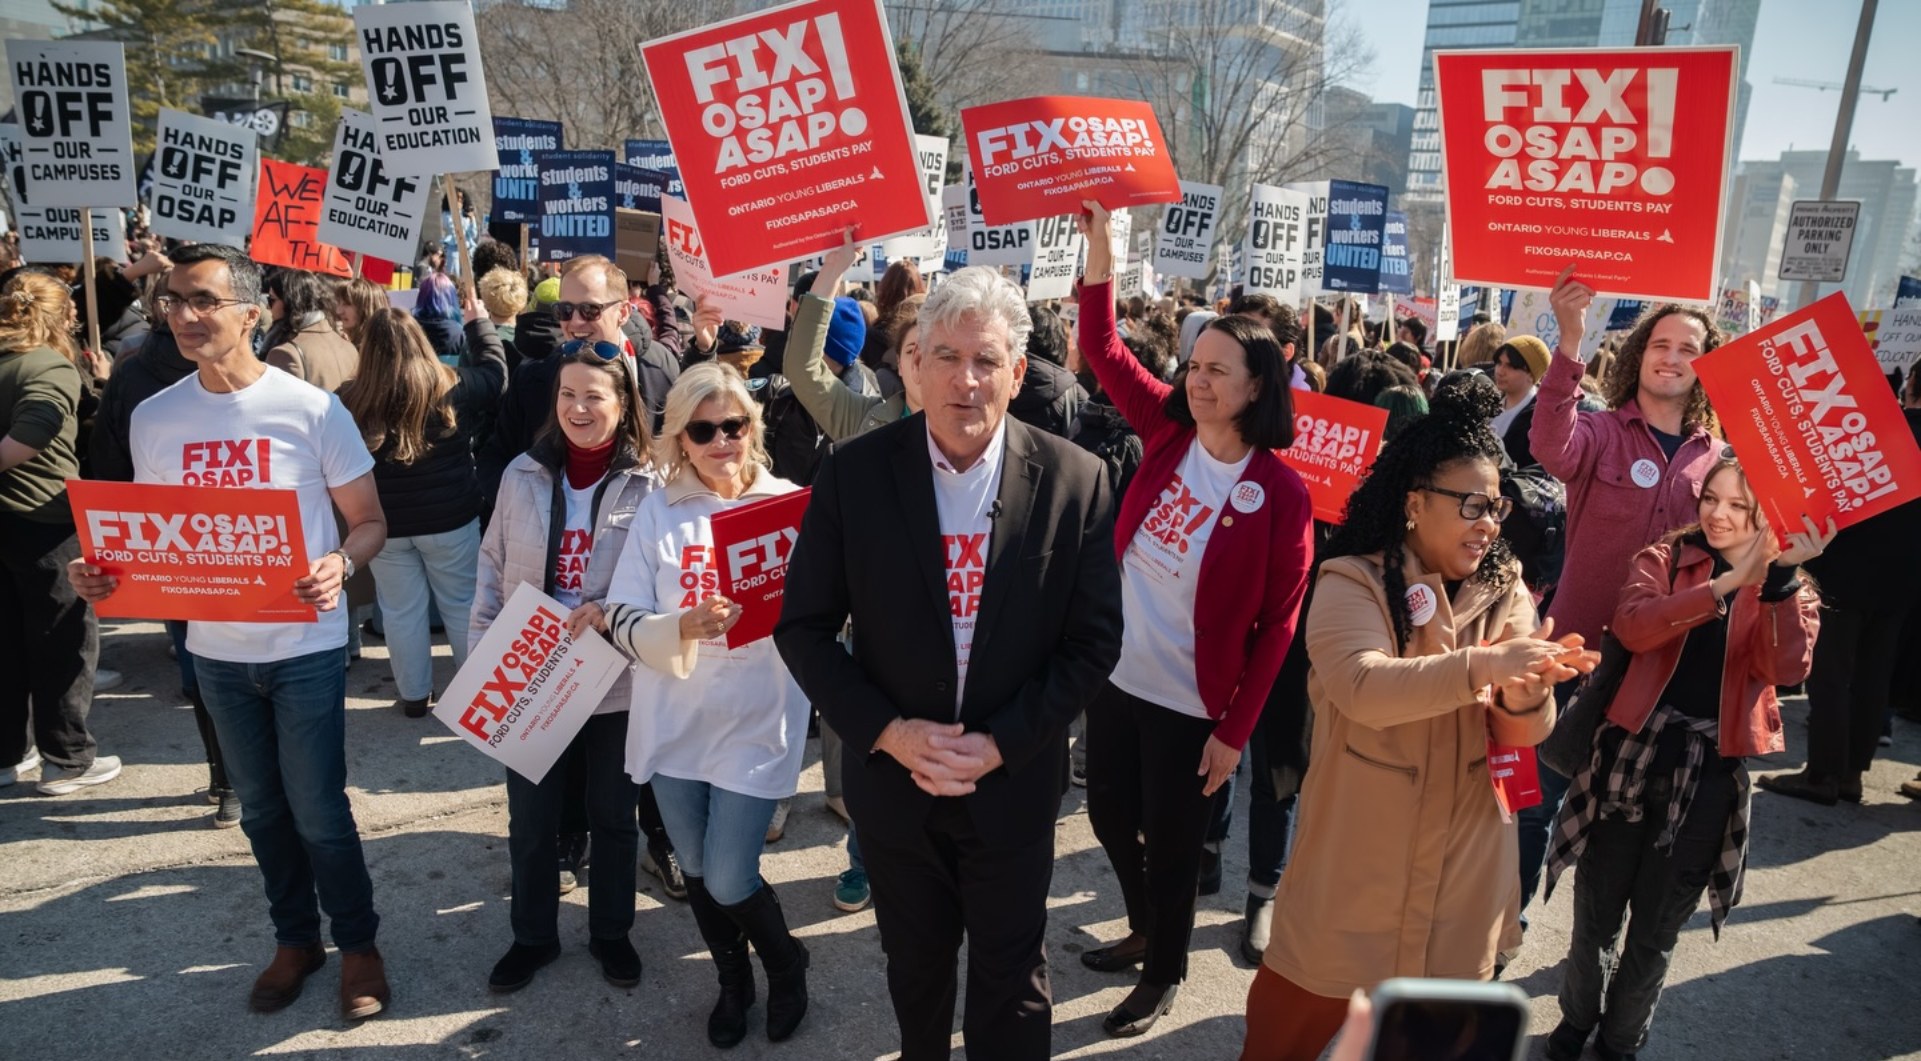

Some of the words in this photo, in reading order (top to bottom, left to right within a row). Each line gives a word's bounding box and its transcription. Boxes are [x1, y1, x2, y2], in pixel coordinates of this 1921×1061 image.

[363, 23, 463, 54] HANDS
[17, 61, 111, 87] HANDS
[371, 53, 468, 106] OFF
[21, 91, 113, 137] OFF
[408, 106, 449, 126] OUR
[701, 77, 827, 138] OSAP
[164, 127, 244, 160] HANDS
[385, 126, 481, 151] EDUCATION
[496, 133, 557, 151] students
[977, 118, 1067, 166] FIX
[1484, 125, 1638, 160] OSAP
[54, 141, 91, 159] OUR
[574, 153, 610, 161] solidarity
[31, 164, 120, 181] CAMPUSES
[161, 146, 242, 190] OFF
[720, 173, 751, 190] FORD
[753, 162, 789, 184] CUTS,
[790, 147, 850, 173] STUDENTS
[851, 140, 873, 156] PAY
[984, 162, 1020, 178] FORD
[1023, 152, 1063, 171] CUTS,
[1065, 147, 1131, 161] STUDENTS
[1135, 147, 1156, 157] PAY
[265, 165, 320, 201] WE
[541, 165, 609, 186] students
[1017, 177, 1054, 190] ONTARIO
[1054, 170, 1083, 183] YOUNG
[1084, 165, 1122, 176] LIBERALS
[1043, 176, 1114, 197] FIXOSAPASAP.CA
[182, 183, 215, 202] OUR
[568, 181, 583, 198] &
[728, 197, 775, 216] ONTARIO
[776, 187, 814, 203] YOUNG
[815, 174, 865, 194] LIBERALS
[157, 194, 236, 230] OSAP
[355, 197, 389, 217] OUR
[545, 196, 608, 215] workers
[766, 200, 858, 230] FIXOSAPASAP.CA
[1254, 201, 1300, 222] HANDS
[1331, 198, 1382, 215] students
[1488, 194, 1523, 206] FORD
[1525, 196, 1567, 210] CUTS,
[1570, 198, 1643, 213] STUDENTS
[1646, 202, 1672, 214] PAY
[329, 209, 409, 241] EDUCATION
[541, 215, 610, 237] UNITED
[1165, 207, 1212, 238] OFF
[1351, 214, 1362, 230] &
[1488, 222, 1542, 234] ONTARIO
[1544, 225, 1588, 237] YOUNG
[1591, 227, 1650, 241] LIBERALS
[1792, 216, 1854, 229] AUTHORIZED
[24, 226, 110, 241] CAMPUES
[972, 228, 1030, 251] OSAP
[1175, 237, 1194, 249] OUR
[1252, 219, 1298, 252] OFF
[1331, 229, 1379, 244] workers
[1797, 229, 1842, 242] PARKING
[289, 241, 350, 272] THIS
[1048, 249, 1065, 262] OUR
[1160, 248, 1204, 263] CAMPUSES
[1265, 252, 1284, 265] OUR
[1326, 244, 1378, 269] UNITED
[1524, 245, 1633, 262] FIXOSAPASAP.CA
[1804, 242, 1830, 254] ONLY
[761, 274, 779, 285] PAY
[1034, 264, 1072, 279] CAMPUSES
[1250, 266, 1295, 289] OSAP
[1525, 268, 1554, 277] Authorized
[1882, 332, 1902, 343] OFF
[1772, 318, 1857, 425] FIX
[1751, 379, 1773, 416] ONTARIO
[1771, 415, 1788, 446] YOUNG
[1784, 443, 1808, 484] LIBERALS
[1757, 339, 1785, 376] FORD
[1777, 378, 1804, 420] CUTS,
[1798, 420, 1842, 490] STUDENTS
[1832, 488, 1853, 513] PAY
[1750, 408, 1790, 480] FIXOSAPASAP.CA
[1280, 448, 1337, 470] STUDENTS
[1340, 462, 1361, 476] PAY
[85, 509, 193, 553] FIX
[95, 549, 134, 562] FORD
[138, 551, 182, 566] CUTS,
[187, 553, 263, 566] STUDENTS
[267, 555, 293, 567] PAY
[131, 574, 172, 582] ONTARIO
[173, 575, 206, 584] YOUNG
[207, 576, 249, 585] LIBERALS
[732, 574, 767, 594] FORD
[161, 586, 240, 596] FIXOSAPASAP.CA
[458, 665, 528, 741] FIX
[488, 723, 510, 748] FORD
[506, 696, 533, 724] CUTS,
[527, 645, 568, 695] STUDENTS
[520, 715, 541, 741] ONTARIO
[540, 694, 557, 715] YOUNG
[554, 668, 576, 695] LIBERALS
[541, 682, 580, 731] FIXOSAPASAP.CA
